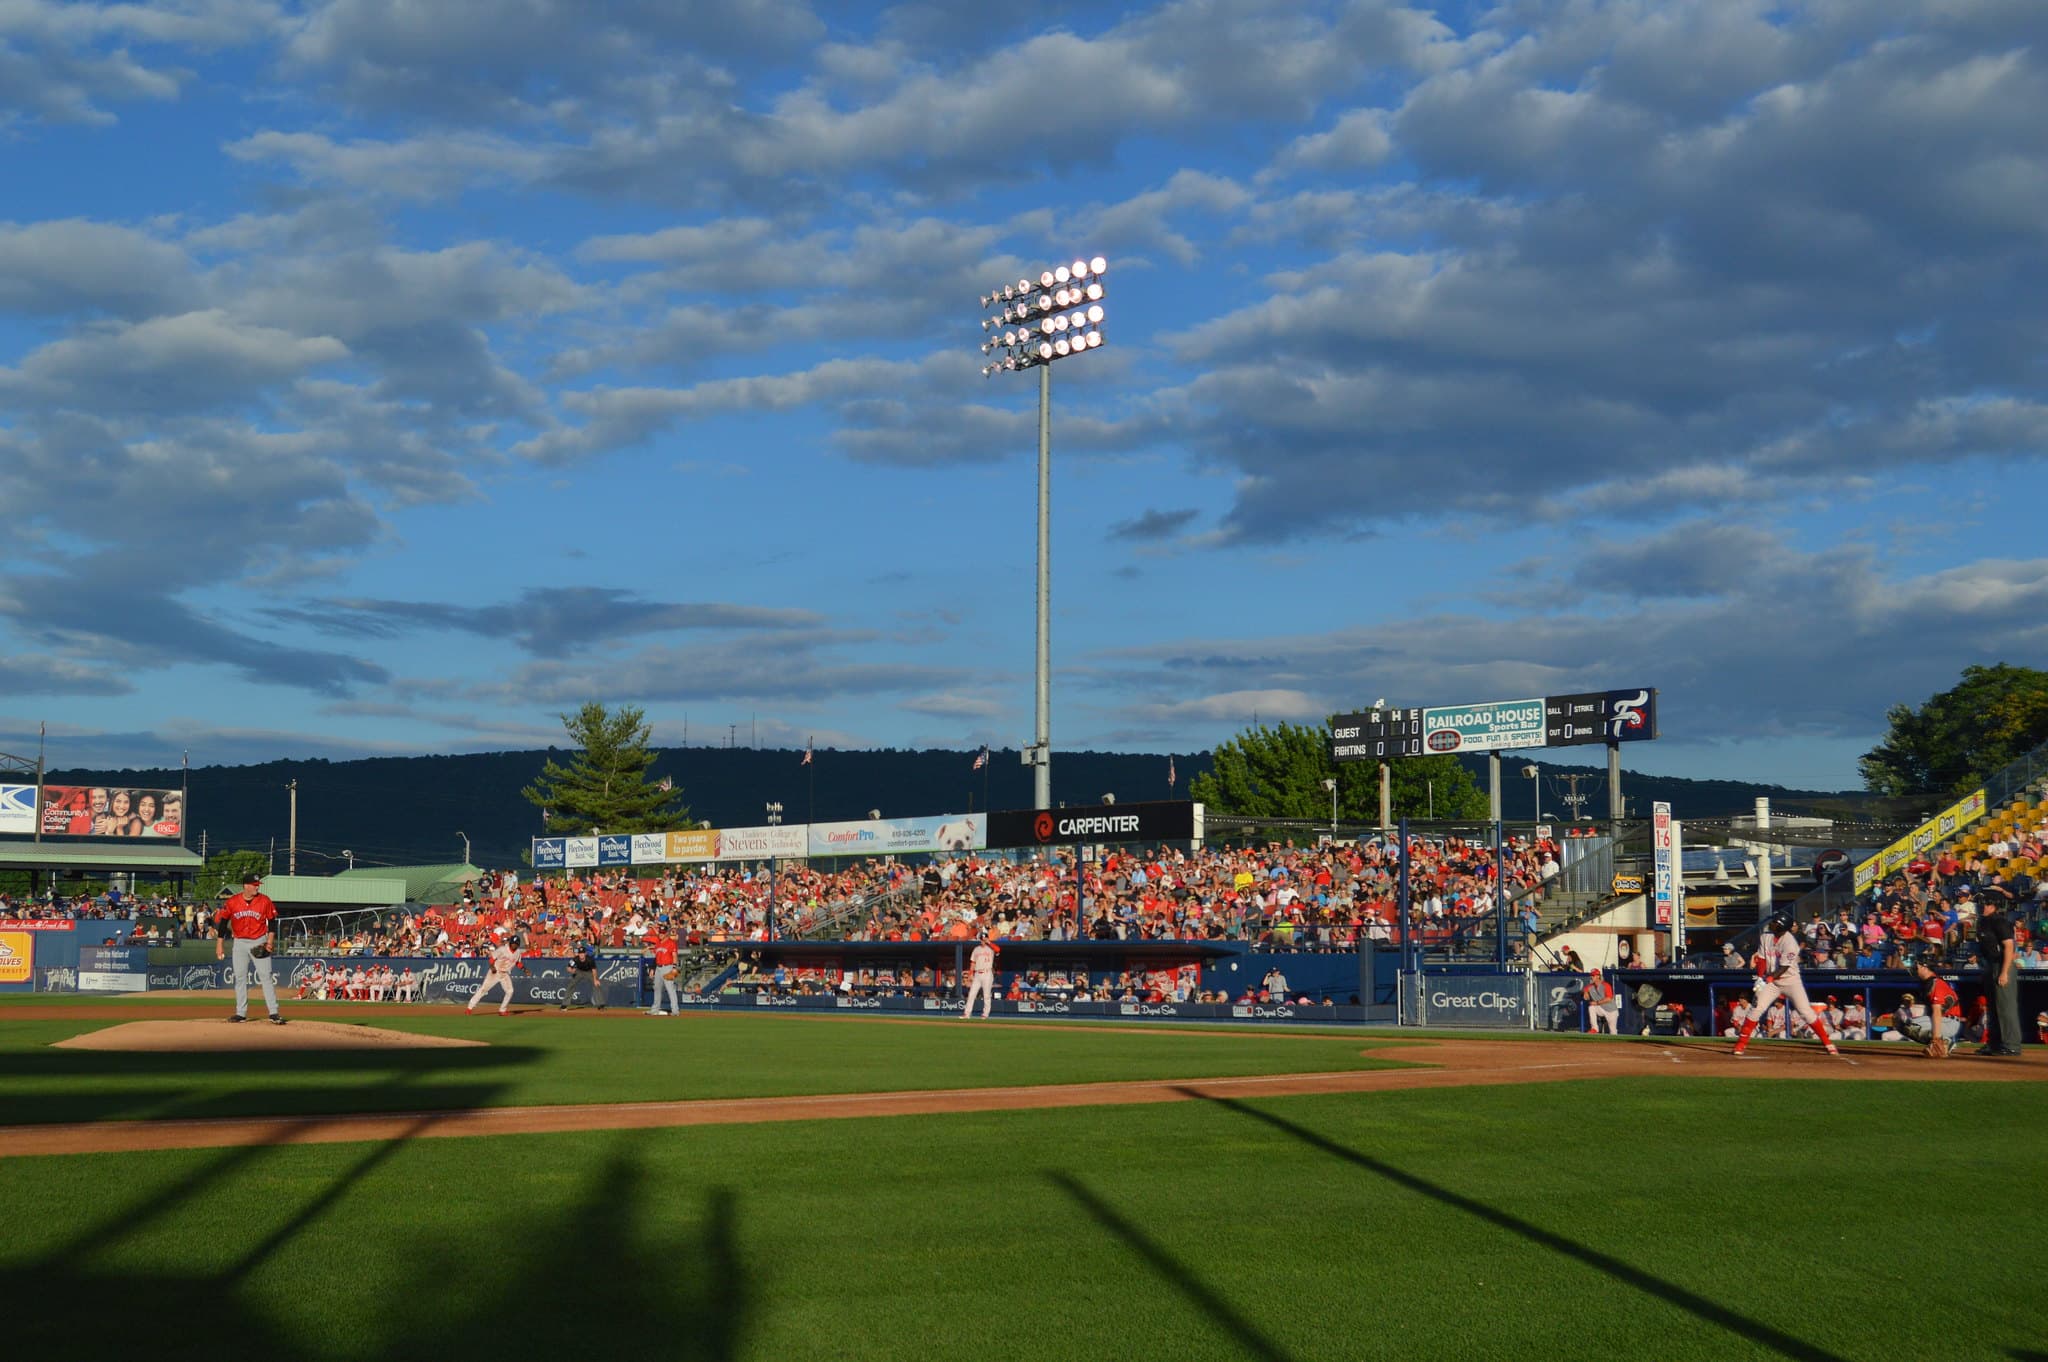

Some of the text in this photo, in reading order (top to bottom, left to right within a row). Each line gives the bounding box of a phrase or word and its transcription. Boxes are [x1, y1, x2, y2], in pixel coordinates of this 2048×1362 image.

[1574, 704, 1594, 713] STRIKE
[1371, 709, 1418, 723] R H E
[1428, 712, 1492, 729] RAILROAD
[1496, 708, 1540, 723] HOUSE
[1334, 727, 1360, 739] GUEST
[1412, 720, 1418, 734] 0
[1489, 721, 1538, 733] Sports Bar
[1548, 724, 1572, 738] OUT 0
[1334, 744, 1366, 756] FIGHTINS
[1376, 742, 1384, 756] 0
[1412, 739, 1419, 752] 0
[45, 801, 59, 809] The
[44, 808, 90, 817] Community's
[44, 816, 72, 824] College
[1058, 815, 1140, 835] CARPENTER
[828, 829, 874, 844] ComfortPro
[1656, 830, 1670, 847] 1-6
[537, 842, 562, 854] Fleetwood
[568, 844, 594, 854] Fleetwood
[600, 841, 627, 852] Fleetwood
[634, 840, 662, 849] Fleetwood
[728, 836, 768, 851] Stevens
[1658, 872, 1670, 890] 1-2
[446, 982, 468, 994] Great
[530, 987, 557, 1000] Great
[1432, 992, 1519, 1013] Great Clips
